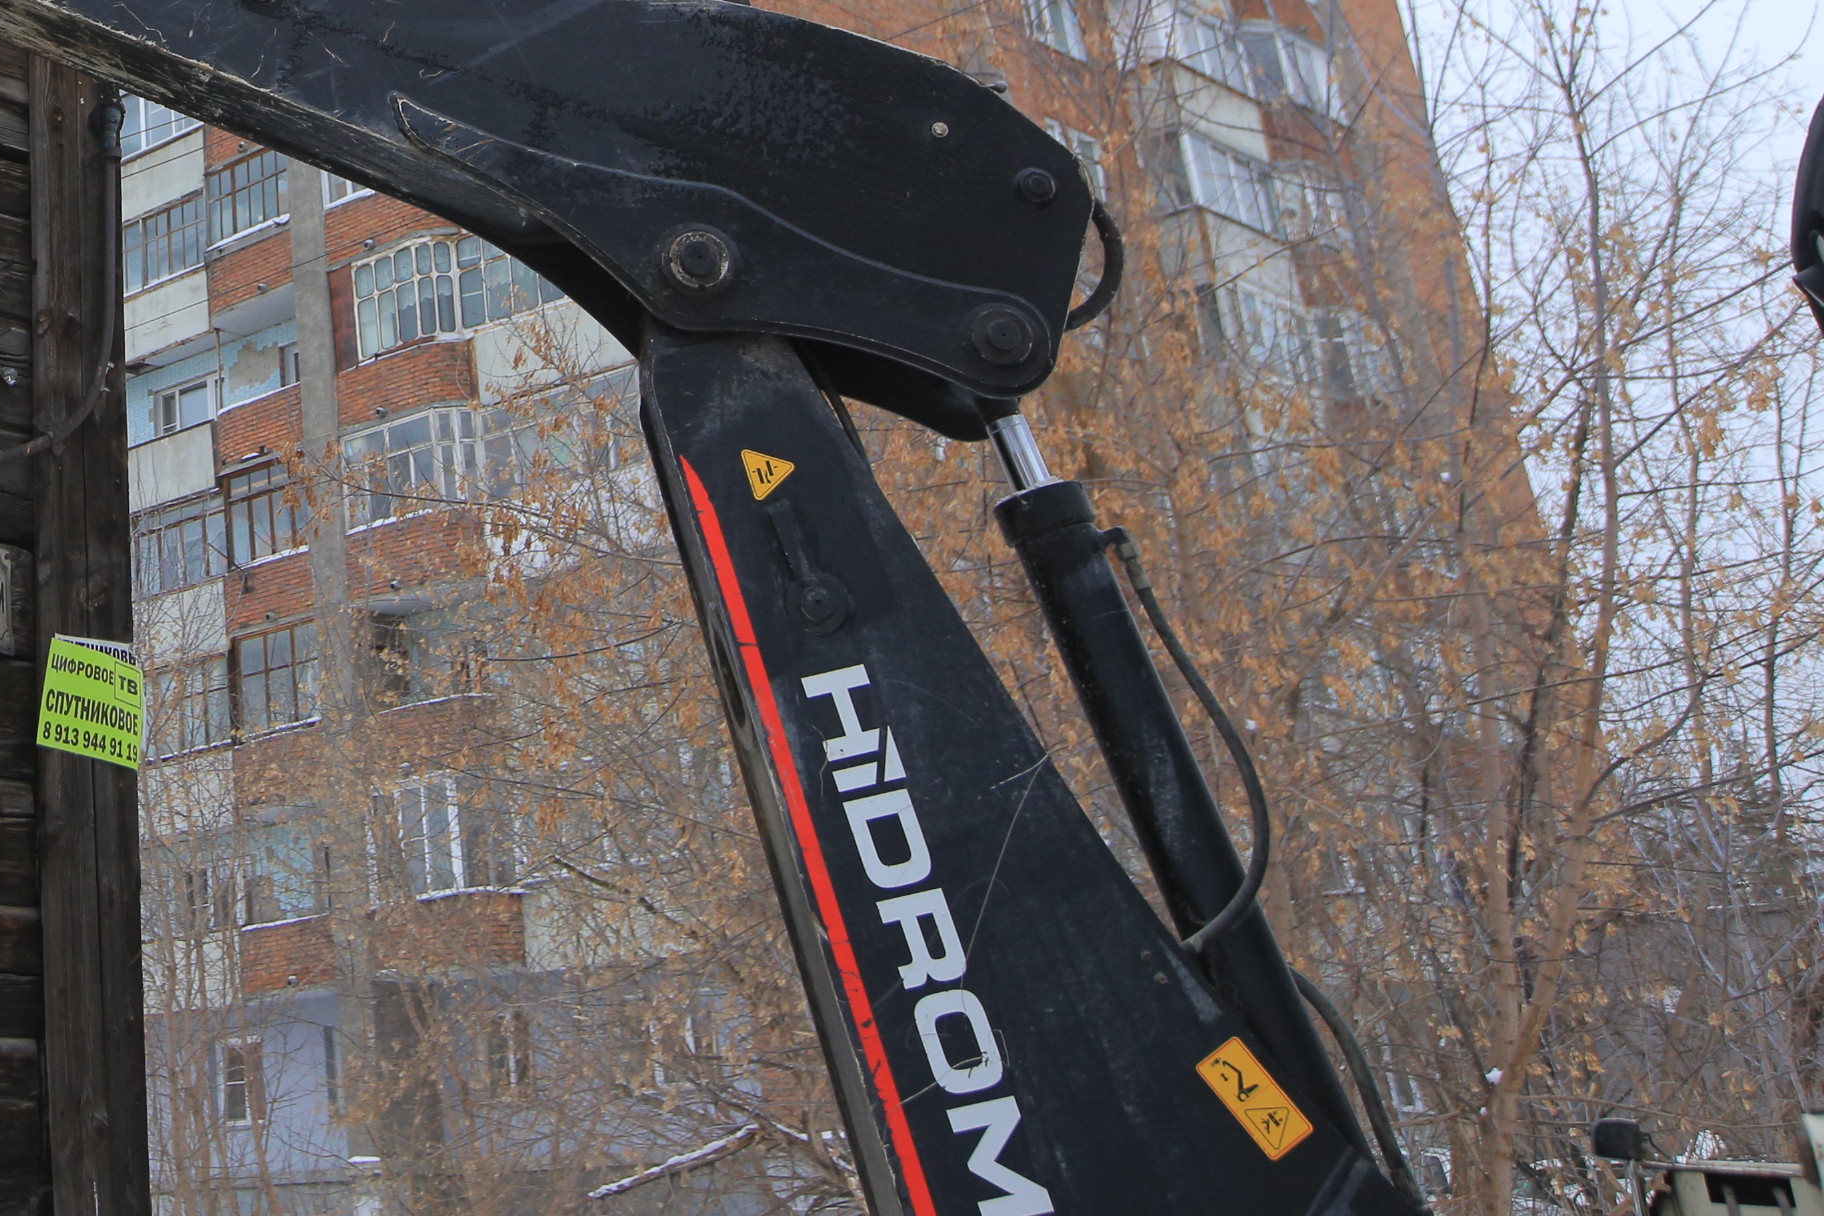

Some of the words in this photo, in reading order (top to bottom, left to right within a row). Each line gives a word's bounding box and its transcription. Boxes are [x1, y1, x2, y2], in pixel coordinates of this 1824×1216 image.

[51, 653, 114, 686] ЦИФРОВОЕ
[118, 675, 138, 695] ТВ
[45, 688, 138, 737] СПУТНИКОВОЕ
[42, 720, 52, 740] 8
[54, 723, 79, 746] 913
[83, 730, 106, 753] 944
[109, 737, 123, 759] 91
[126, 743, 138, 763] 19
